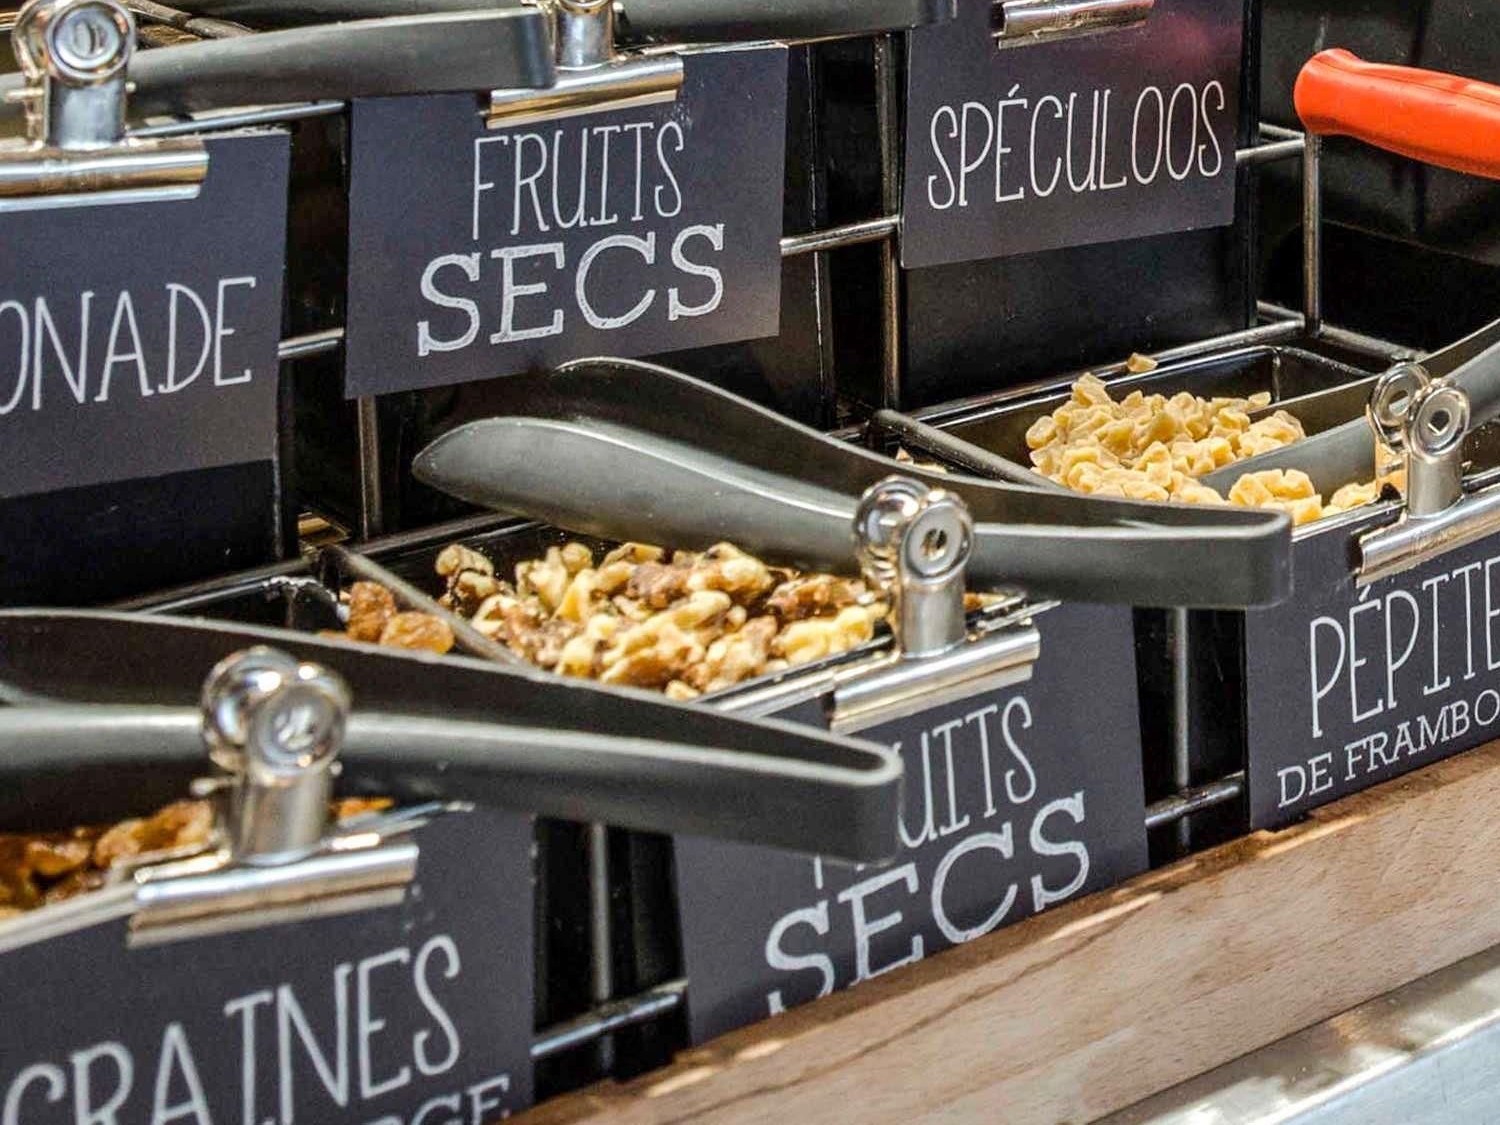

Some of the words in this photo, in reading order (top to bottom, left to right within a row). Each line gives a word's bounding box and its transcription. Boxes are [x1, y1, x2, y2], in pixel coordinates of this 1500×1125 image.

[472, 121, 685, 241] FRUITS
[927, 80, 1225, 210] SPÉCULOOS
[417, 223, 724, 356] SECS
[1277, 756, 1334, 809] DE
[765, 790, 1091, 1017] SECS
